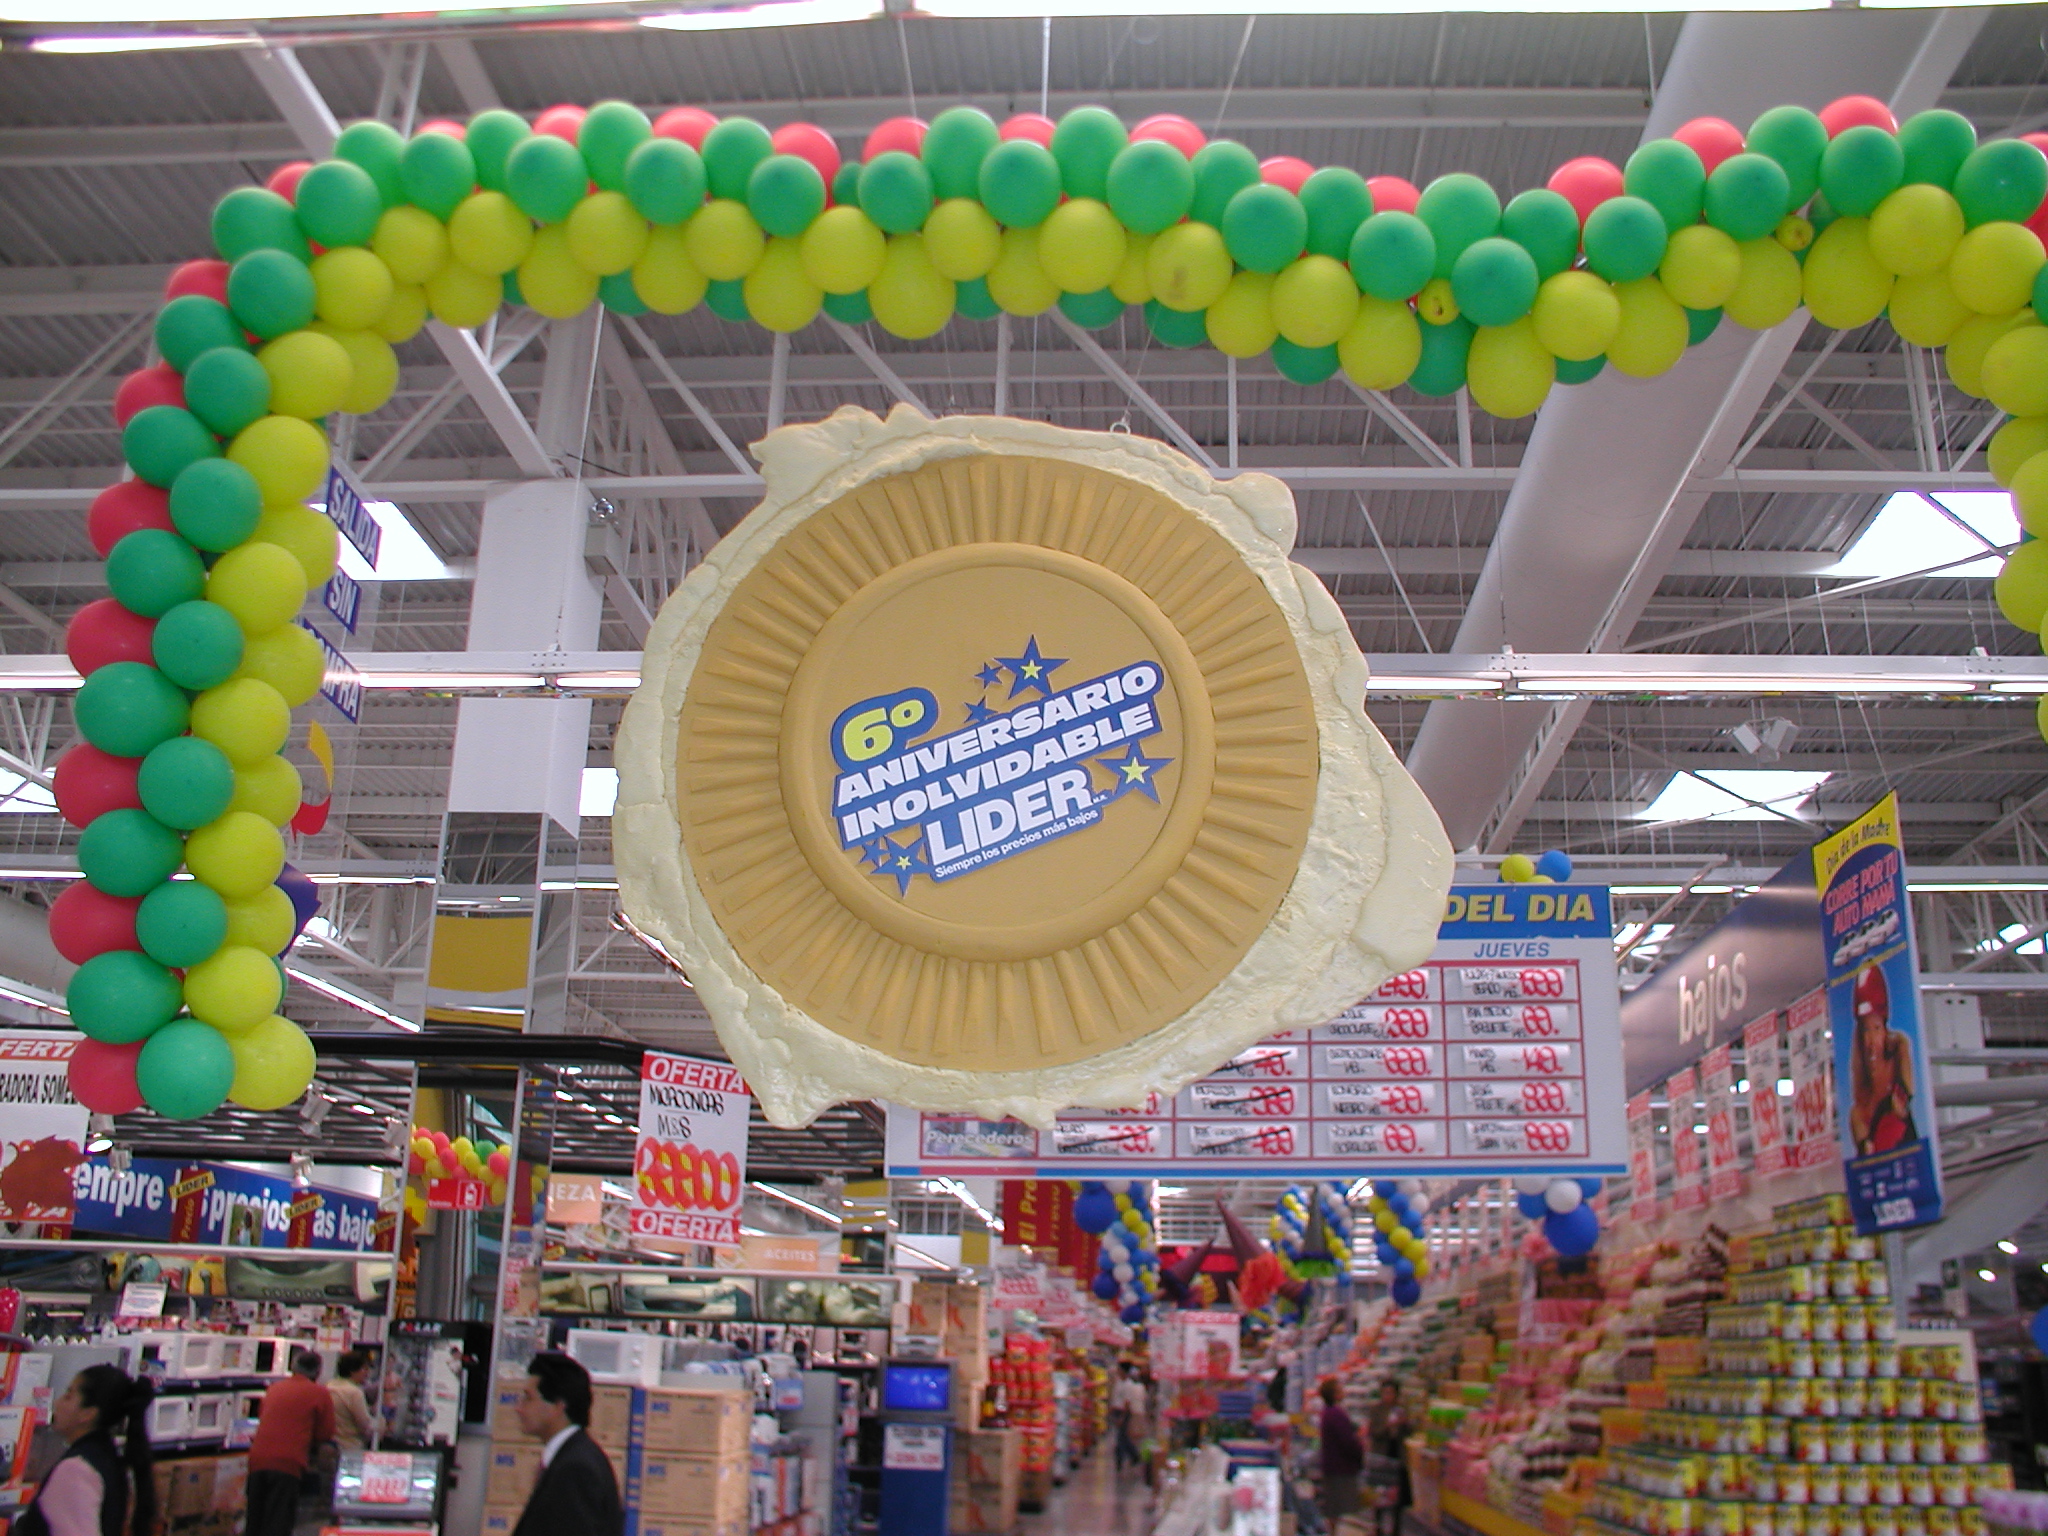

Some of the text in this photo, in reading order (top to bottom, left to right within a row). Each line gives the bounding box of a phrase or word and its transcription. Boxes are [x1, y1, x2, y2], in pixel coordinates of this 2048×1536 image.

[330, 476, 378, 561] SALIDA
[329, 573, 358, 624] SIN
[837, 665, 1158, 807] ANIVERSARIO
[842, 702, 1155, 843] INOLVIDABLE
[926, 768, 1094, 866] LIDER
[935, 810, 1099, 878] Siempre los precios más bajos
[1443, 894, 1595, 922] DEL DIA
[1474, 943, 1550, 959] JUEVES
[1678, 952, 1749, 1049] bajos
[649, 1058, 745, 1093] OFERTA
[926, 1130, 1034, 1147] Perecederos
[175, 1176, 210, 1197] LIDER
[637, 1212, 735, 1242] OFERTA
